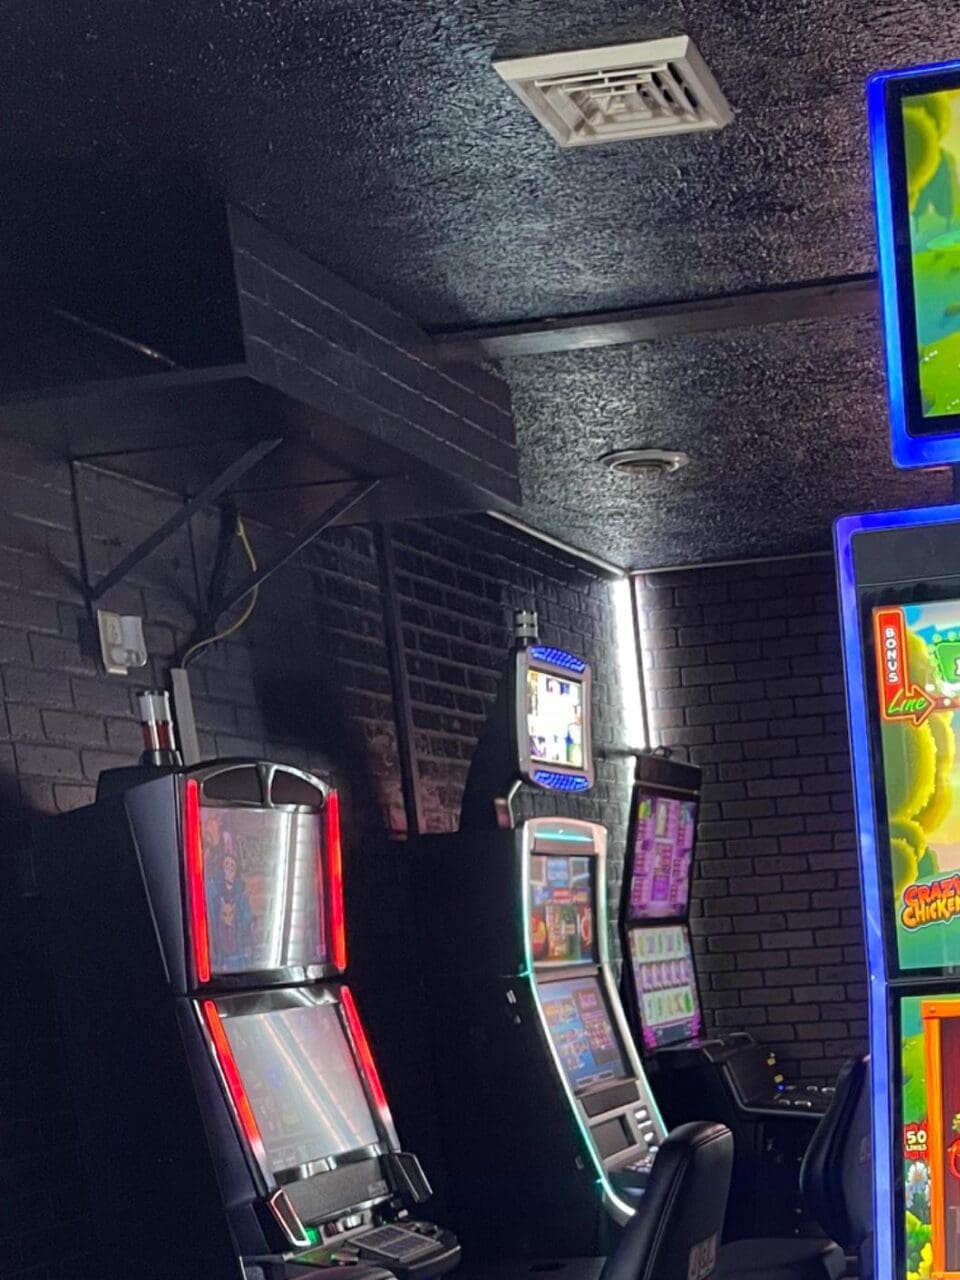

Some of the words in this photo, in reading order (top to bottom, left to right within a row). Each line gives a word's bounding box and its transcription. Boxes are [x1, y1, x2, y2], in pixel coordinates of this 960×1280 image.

[884, 628, 899, 684] BONUS
[887, 688, 928, 714] Line
[906, 1130, 927, 1144] 50
